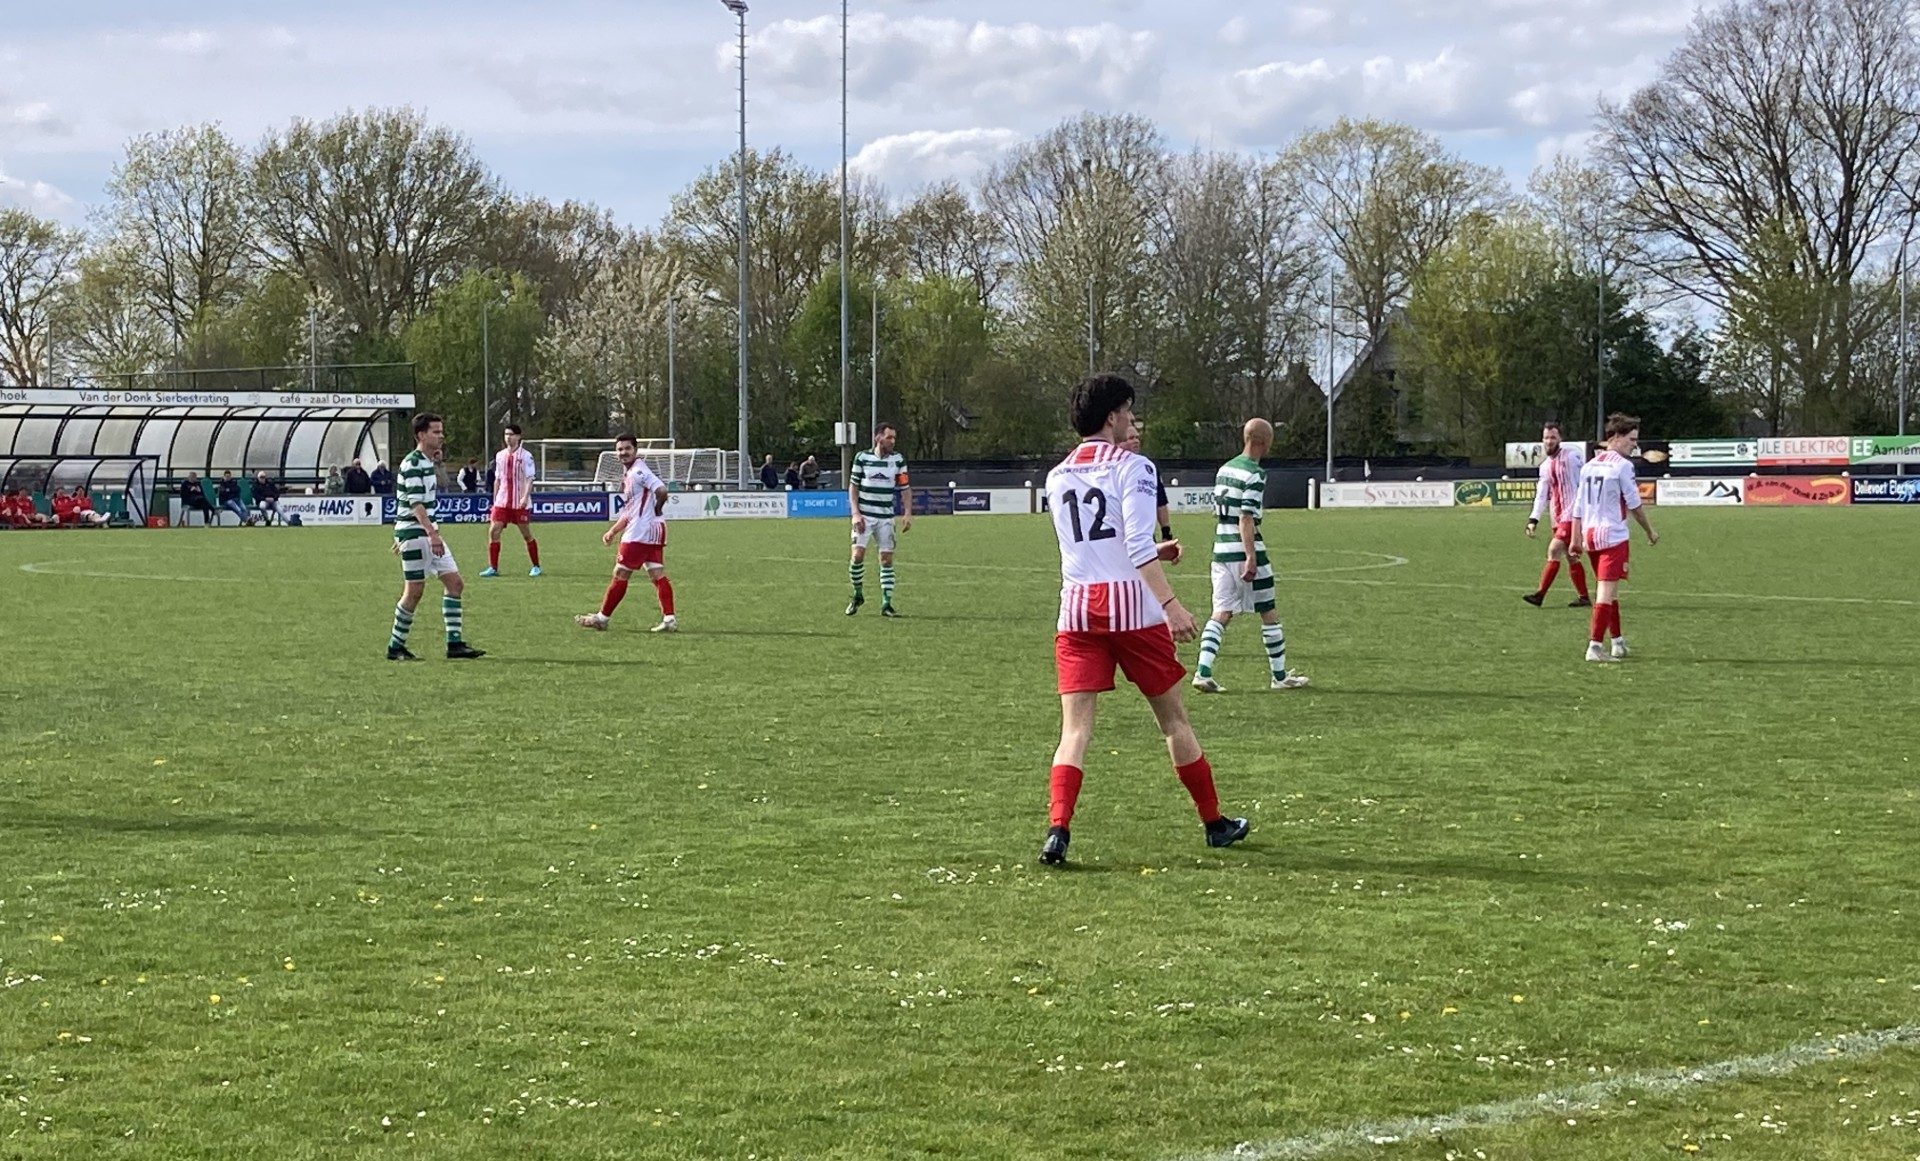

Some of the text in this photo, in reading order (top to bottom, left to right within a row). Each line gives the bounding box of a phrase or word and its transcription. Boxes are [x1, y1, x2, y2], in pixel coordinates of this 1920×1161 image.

[79, 391, 230, 405] Van der Donk Sierbestrating
[279, 393, 301, 404] café
[309, 393, 329, 404] zaal
[332, 394, 352, 405] Den
[355, 394, 400, 406] Driehoek
[1760, 439, 1847, 455] JLE ELEKTRO
[1852, 439, 1873, 456] EE
[1364, 486, 1449, 504] SWINKELS
[1586, 476, 1604, 505] 17
[318, 499, 355, 516] HANS
[533, 502, 601, 514] LOEGAM
[722, 501, 770, 509] VERSTEGEN
[1062, 487, 1117, 543] 12
